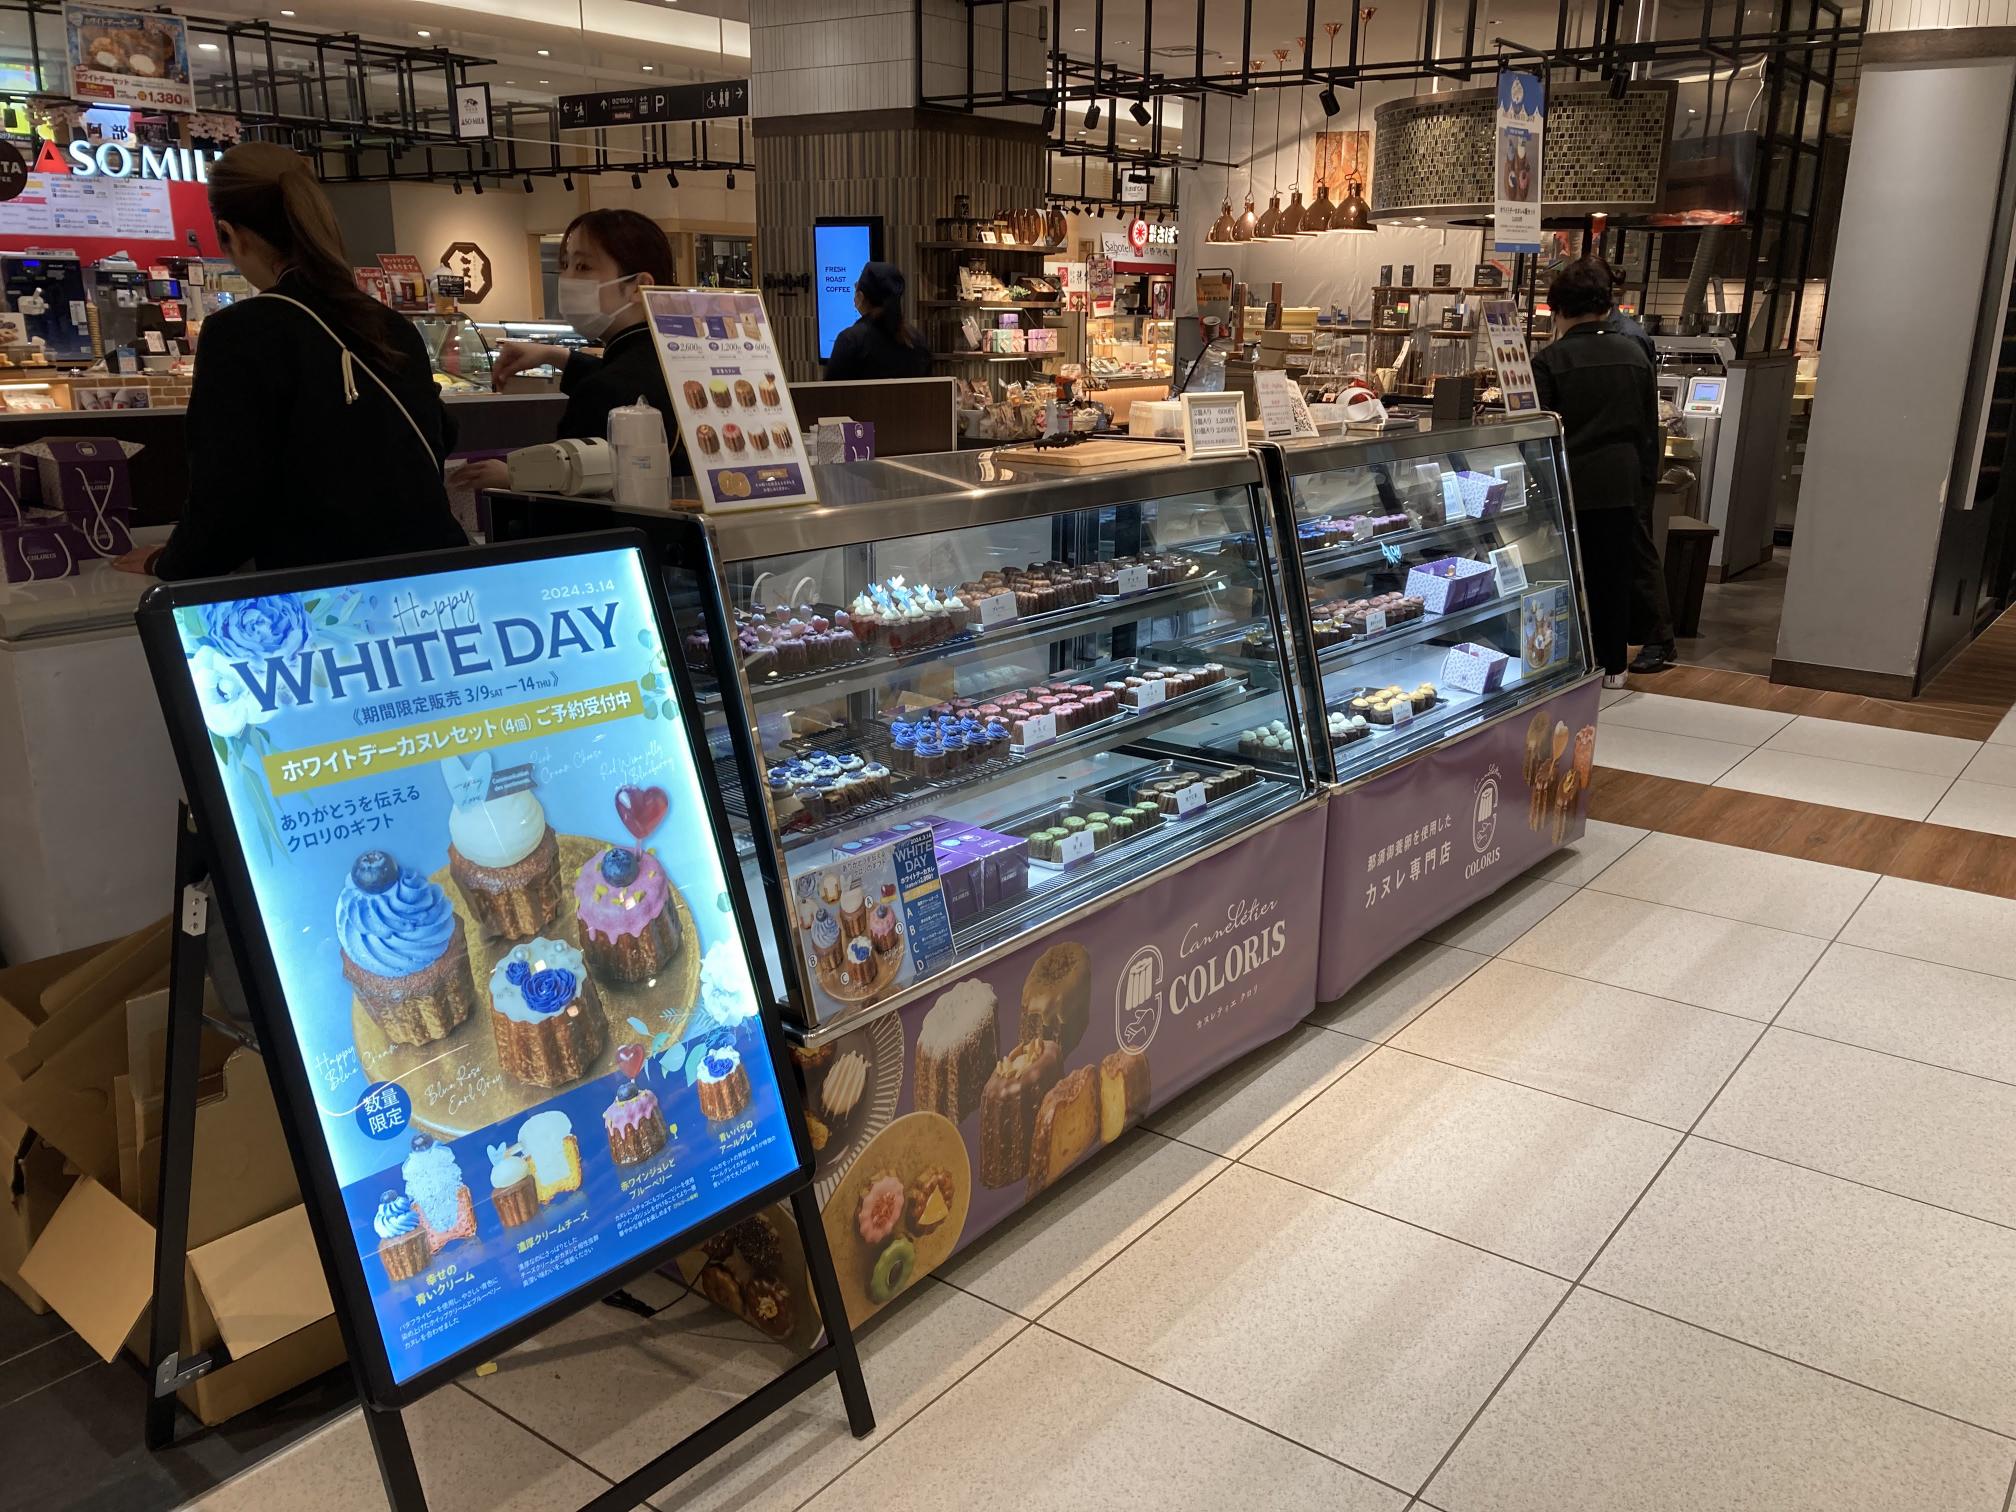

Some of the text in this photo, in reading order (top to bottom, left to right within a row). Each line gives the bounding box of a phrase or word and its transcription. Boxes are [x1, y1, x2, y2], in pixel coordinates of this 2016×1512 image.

[655, 95, 665, 112] P
[34, 140, 223, 185] ASO MIL
[541, 579, 615, 601] 2024.3.14
[393, 589, 475, 636] Happy
[230, 601, 619, 712] WHITE DAY
[536, 690, 633, 727] ご予約受付中
[280, 785, 421, 832] ありがとうを伝える
[287, 812, 395, 853] クロリのギフト
[894, 840, 933, 863] WHITE
[904, 853, 927, 873] DAY
[1465, 846, 1501, 880] COLORIS
[1365, 841, 1452, 909] カヌレ専門店
[906, 907, 914, 919] A
[909, 924, 916, 936] B
[912, 942, 920, 953] C
[916, 959, 924, 971] D
[1169, 919, 1287, 1015] COLORIS
[314, 1044, 356, 1074] Happy
[363, 1087, 401, 1117] 数量
[368, 1107, 405, 1137] 限定
[719, 1119, 754, 1144] 青いバラの
[720, 1128, 757, 1156] アールグレイ
[620, 1157, 676, 1192] 赤ワインジュレと
[629, 1173, 673, 1200] ブルーベリー
[415, 1271, 476, 1307] 青いクリーム
[426, 1263, 458, 1287] 幸せの
